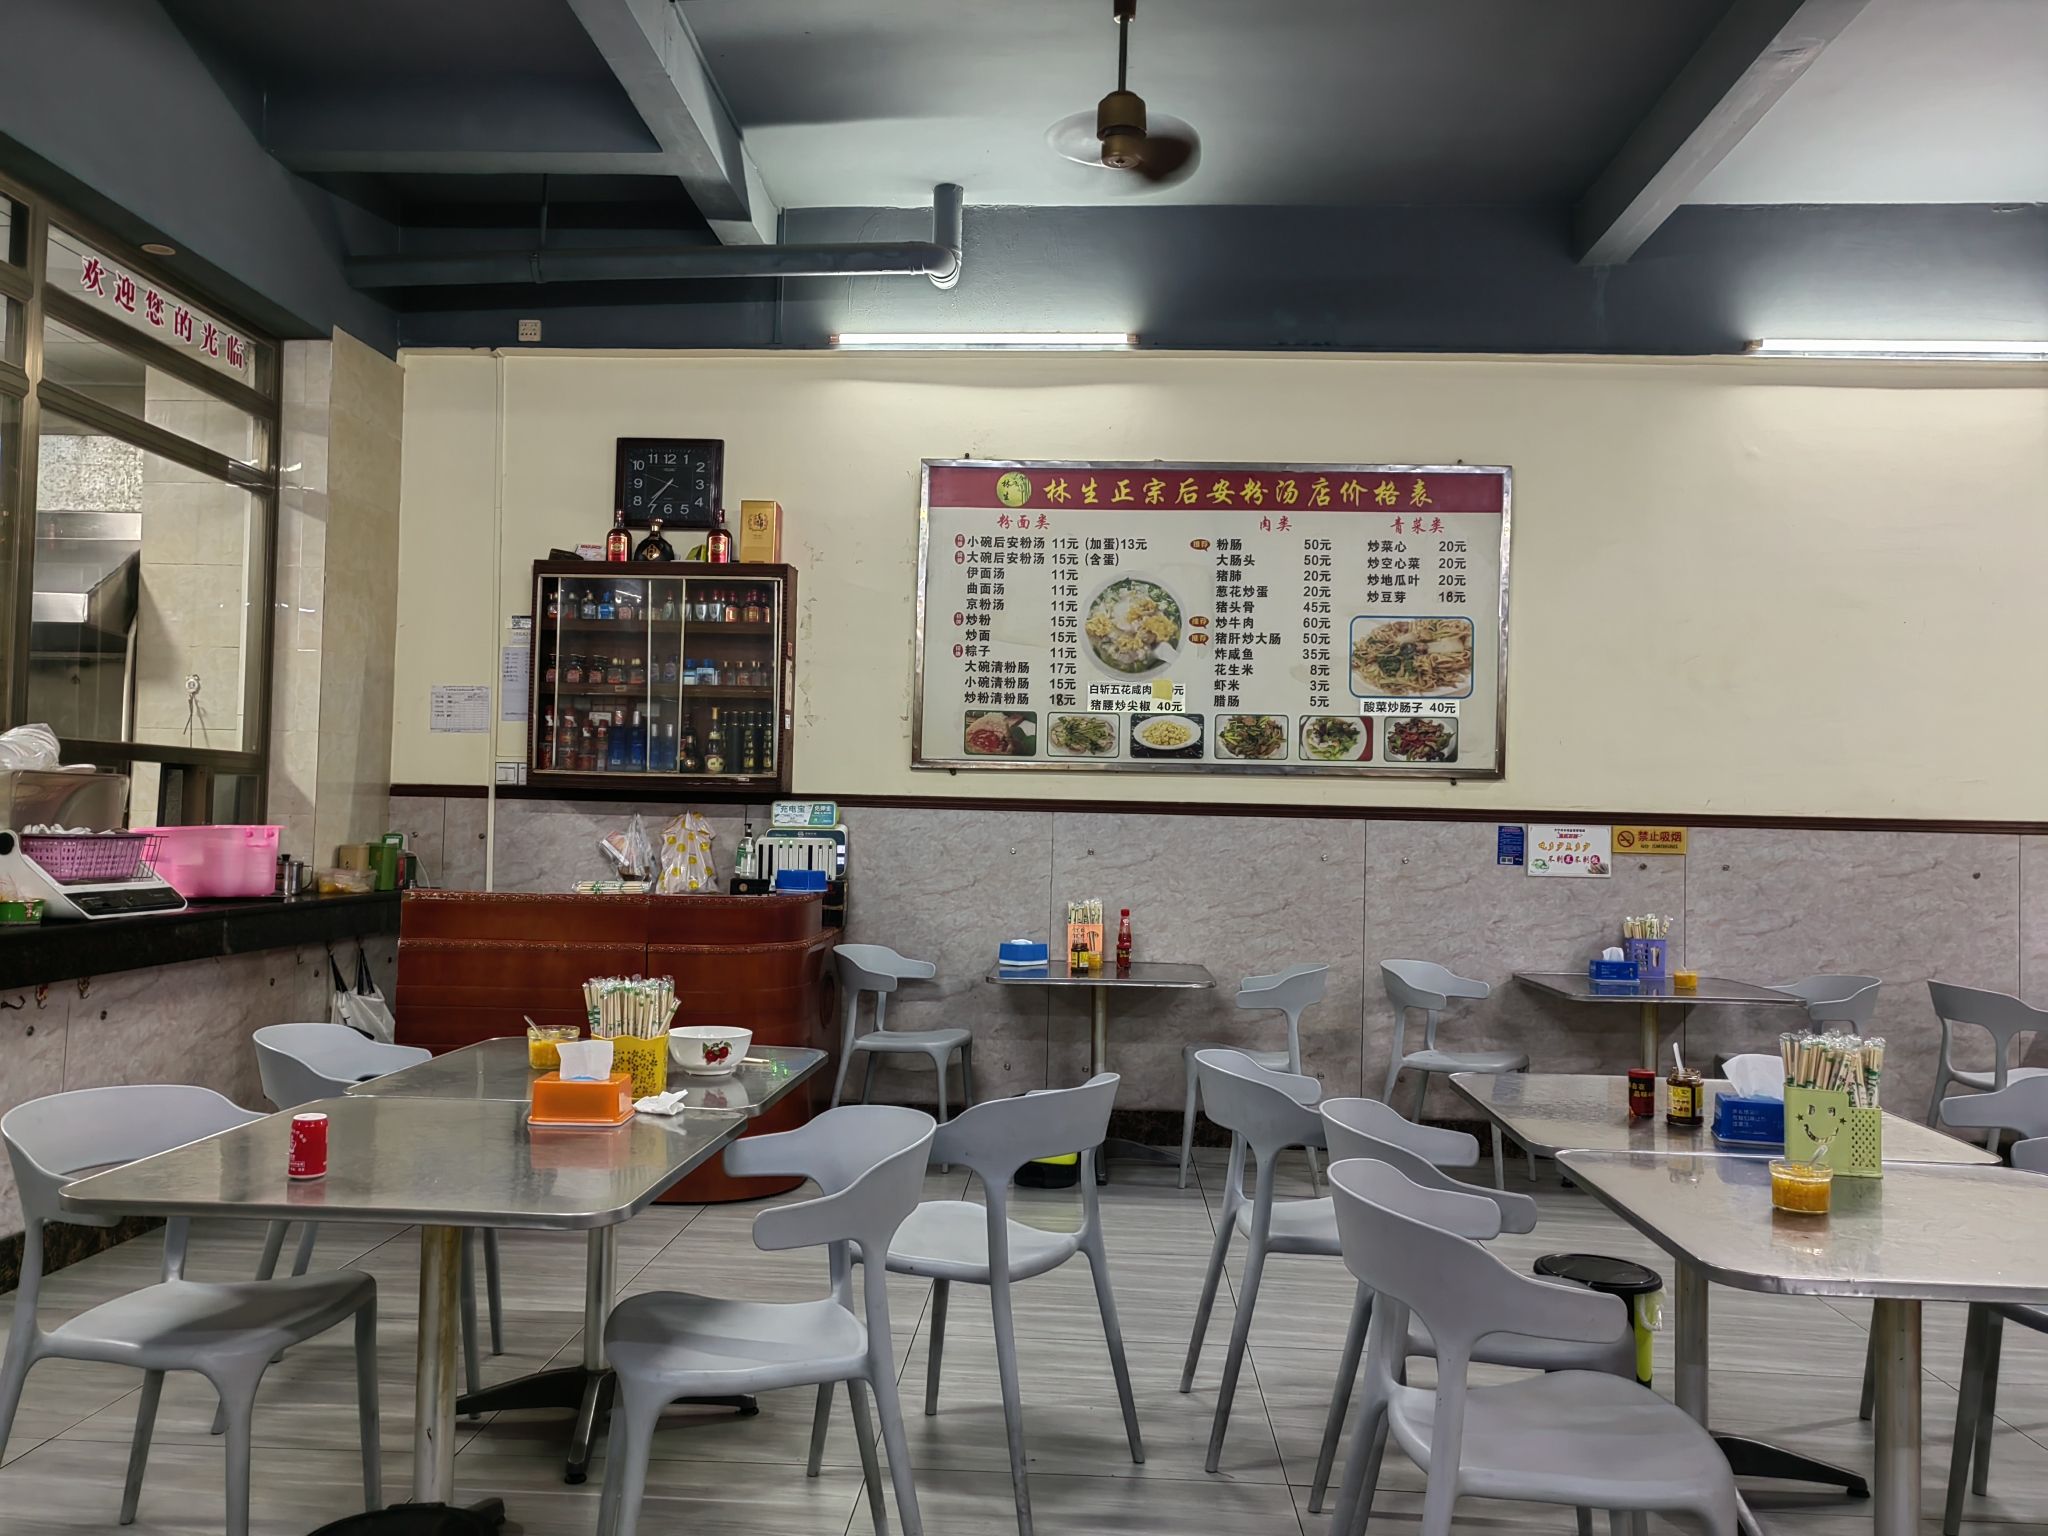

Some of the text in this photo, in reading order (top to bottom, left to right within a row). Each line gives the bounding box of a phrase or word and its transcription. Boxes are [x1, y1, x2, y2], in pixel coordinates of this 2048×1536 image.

[81, 257, 244, 370] 欢迎您的光临
[649, 453, 658, 464] 11
[664, 453, 677, 464] 12
[684, 454, 689, 464] 1
[633, 460, 645, 470] 10
[696, 462, 705, 472] 2
[634, 478, 643, 488] 9
[695, 479, 705, 490] 3
[1043, 477, 1433, 508] 林生正宗后安粉汤店价格表
[633, 496, 642, 506] 8
[694, 497, 703, 507] 4
[650, 504, 657, 514] 7
[664, 504, 673, 514] 6
[680, 504, 689, 515] 5
[996, 514, 1050, 530] 粉面类
[1259, 515, 1293, 532] 肉类
[1391, 516, 1446, 534] 青菜类
[967, 536, 1045, 549] 小碗后安粉汤
[1052, 538, 1079, 549] 11元
[1217, 539, 1331, 550] 粉肠 50元
[1368, 540, 1466, 552] 炒菜心 20元
[967, 551, 1045, 564] 大碗后安粉汤
[1052, 554, 1078, 565] 15元
[1085, 553, 1119, 566] (含蛋)
[1216, 554, 1331, 566] 大肠头 50元
[1368, 557, 1466, 569] 炒空心菜 20元
[967, 567, 1078, 580] 伊面汤 11元
[1216, 570, 1331, 582] 猪肺 20元
[1367, 574, 1466, 586] 炒地瓜叶 20元
[967, 582, 1078, 596] 曲面汤 11元
[1216, 585, 1331, 597] 葱花炒蛋 20元
[1367, 591, 1466, 603] 炒豆芽 18元
[966, 598, 1077, 612] 京粉汤 11元
[1216, 601, 1331, 613] 猪头骨 45元
[966, 613, 991, 626] 炒粉
[1051, 616, 1077, 627] 15元
[1216, 617, 1331, 629] 炒牛肉 60元
[966, 629, 1077, 643] 炒面 15元
[1215, 632, 1330, 644] 猪肝炒大肠 50元
[965, 645, 991, 657] 粽子
[1050, 647, 1077, 659] 11元
[1215, 648, 1330, 660] 炸咸鱼 35元
[965, 661, 1076, 674] 大碗清粉肠 17元
[1215, 663, 1330, 676] 花生米 8元
[965, 677, 1076, 690] 小碗清粉肠 15元
[1089, 684, 1152, 695] 白斩五花咸肉
[1214, 679, 1329, 691] 虾米 3元
[964, 692, 1076, 706] 炒粉清粉肠 18元
[1214, 695, 1329, 707] 腊肠 5元
[1090, 700, 1182, 711] 猪腰炒尖椒 40元
[1364, 701, 1456, 713] 酸菜炒肠子 40元
[1638, 831, 1682, 842] 禁止吸烟
